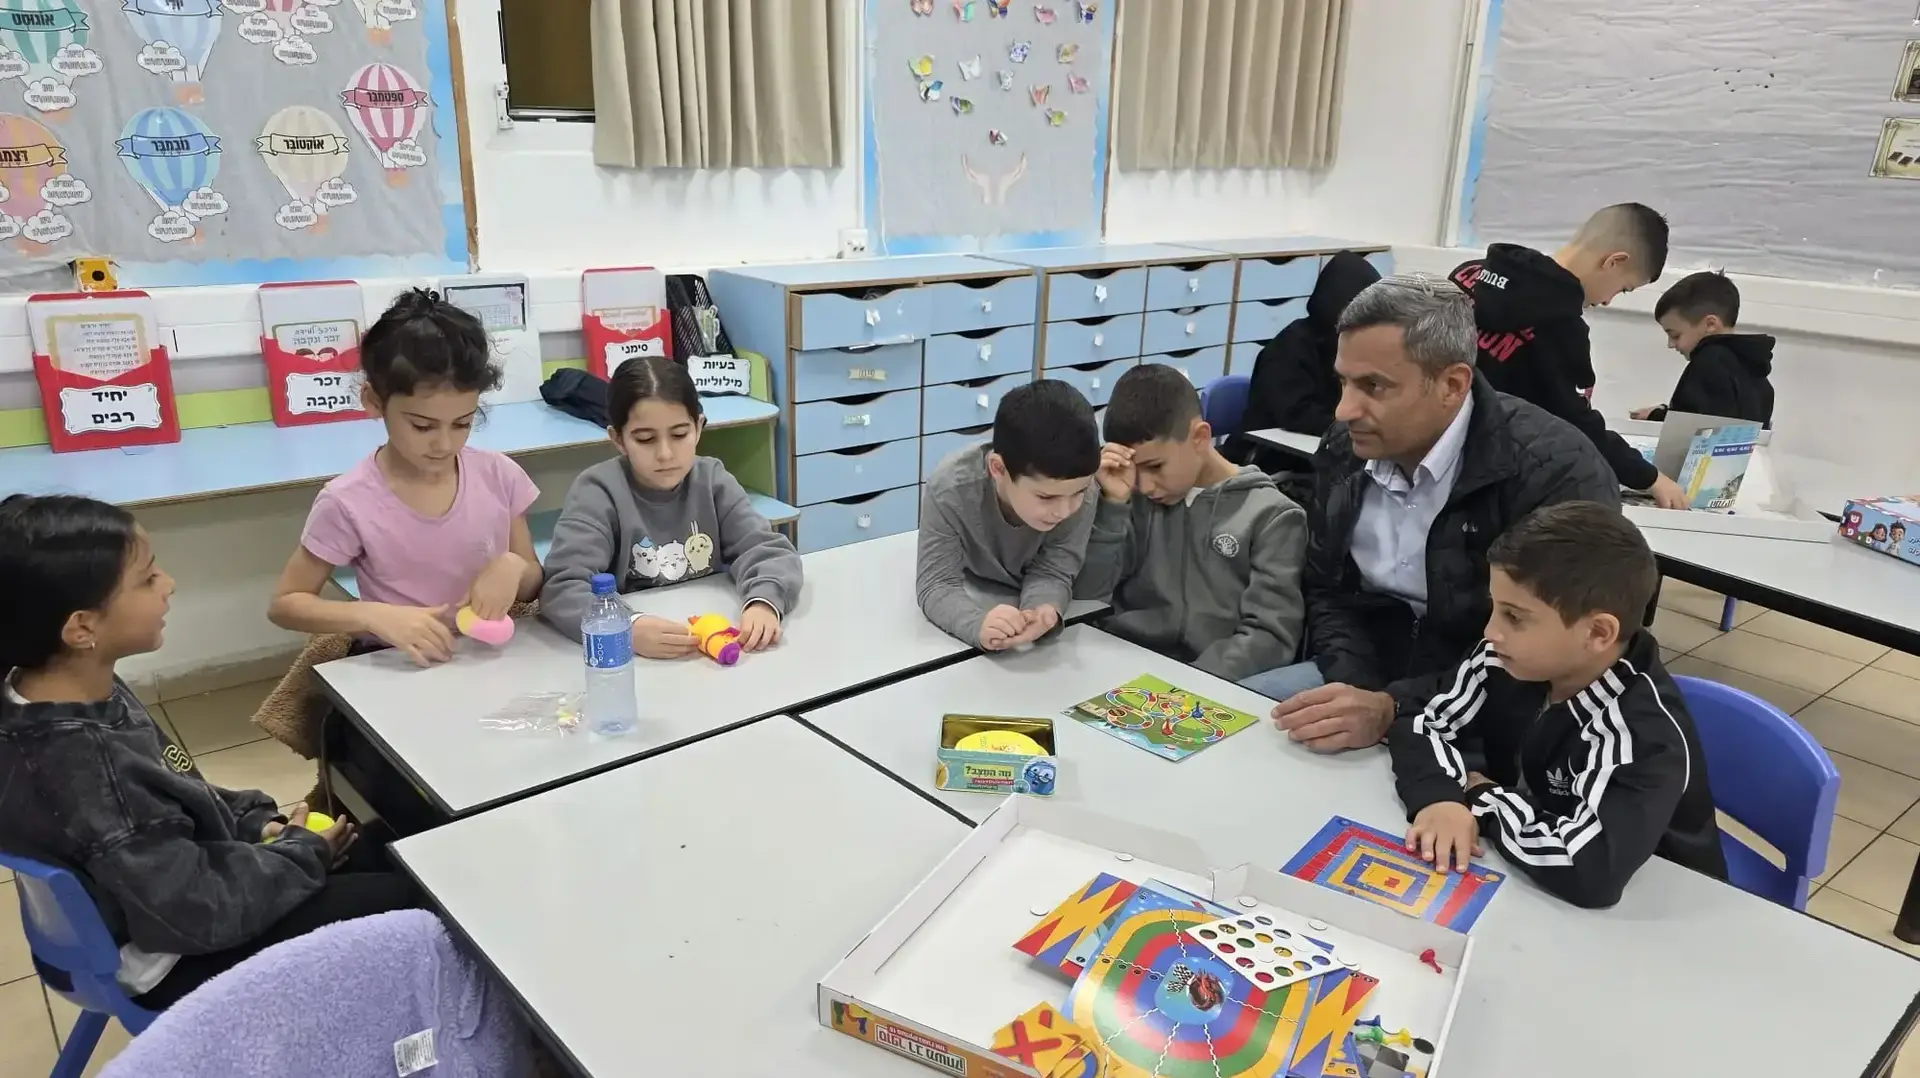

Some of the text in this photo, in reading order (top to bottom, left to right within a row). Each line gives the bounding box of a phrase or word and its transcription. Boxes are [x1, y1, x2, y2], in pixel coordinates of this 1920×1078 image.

[11, 13, 55, 26] אוגוסט
[366, 91, 404, 103] ספטמבר
[151, 139, 190, 151] נובמבר
[283, 138, 325, 150] אוקטובר
[0, 150, 29, 162] דצמ
[621, 343, 649, 354] סימני
[702, 360, 736, 370] בעיות
[313, 376, 342, 387] זכר
[695, 375, 743, 388] מילוליות
[91, 390, 128, 403] יחיד
[306, 394, 351, 410] ונקבה
[91, 410, 135, 425] רבים
